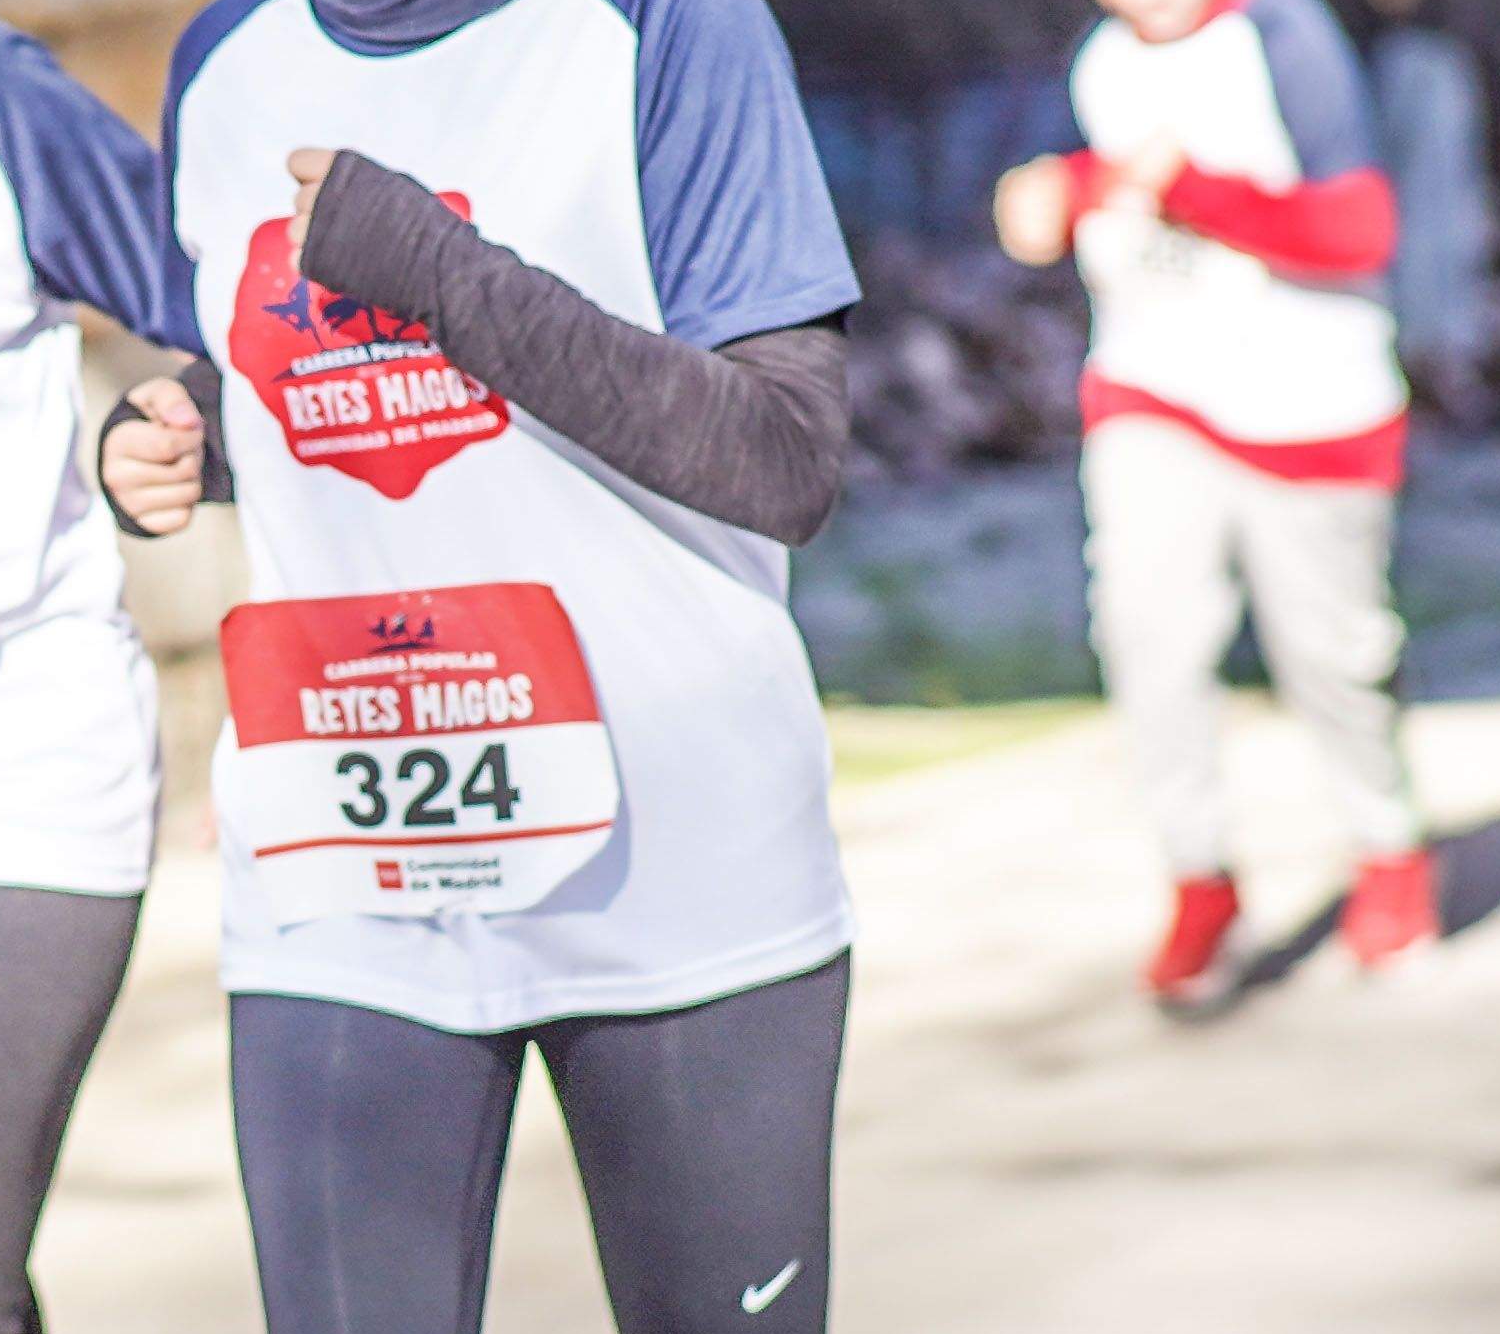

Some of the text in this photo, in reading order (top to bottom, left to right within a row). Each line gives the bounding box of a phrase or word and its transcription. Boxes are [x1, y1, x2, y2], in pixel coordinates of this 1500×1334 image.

[282, 379, 372, 431] REYES
[299, 673, 534, 734] REYES MAGOS
[336, 742, 521, 827] 324
